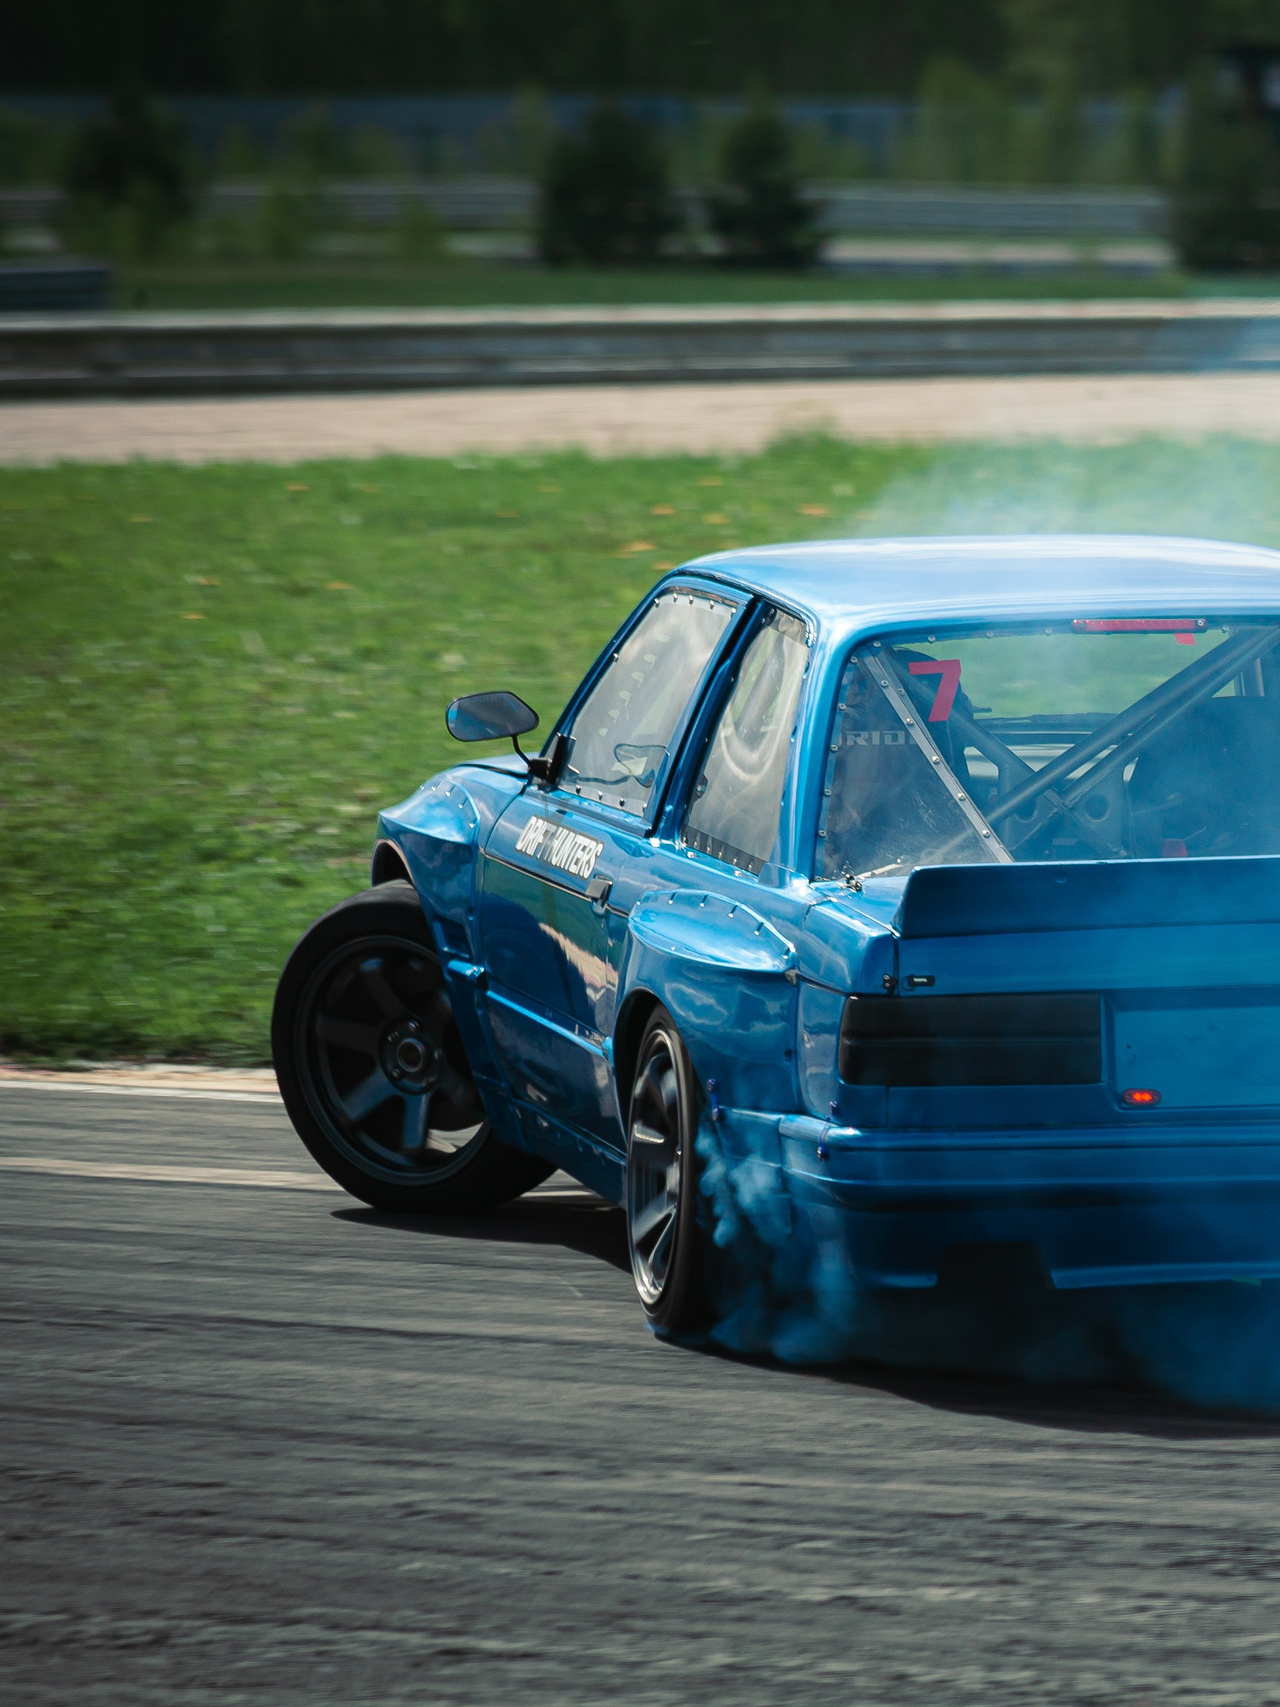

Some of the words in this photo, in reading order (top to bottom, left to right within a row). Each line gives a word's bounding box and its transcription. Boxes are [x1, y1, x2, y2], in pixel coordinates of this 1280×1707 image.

[908, 659, 962, 722] 7
[838, 730, 917, 747] RID
[515, 815, 558, 860] DRIFT
[543, 826, 604, 879] HUNTERS
